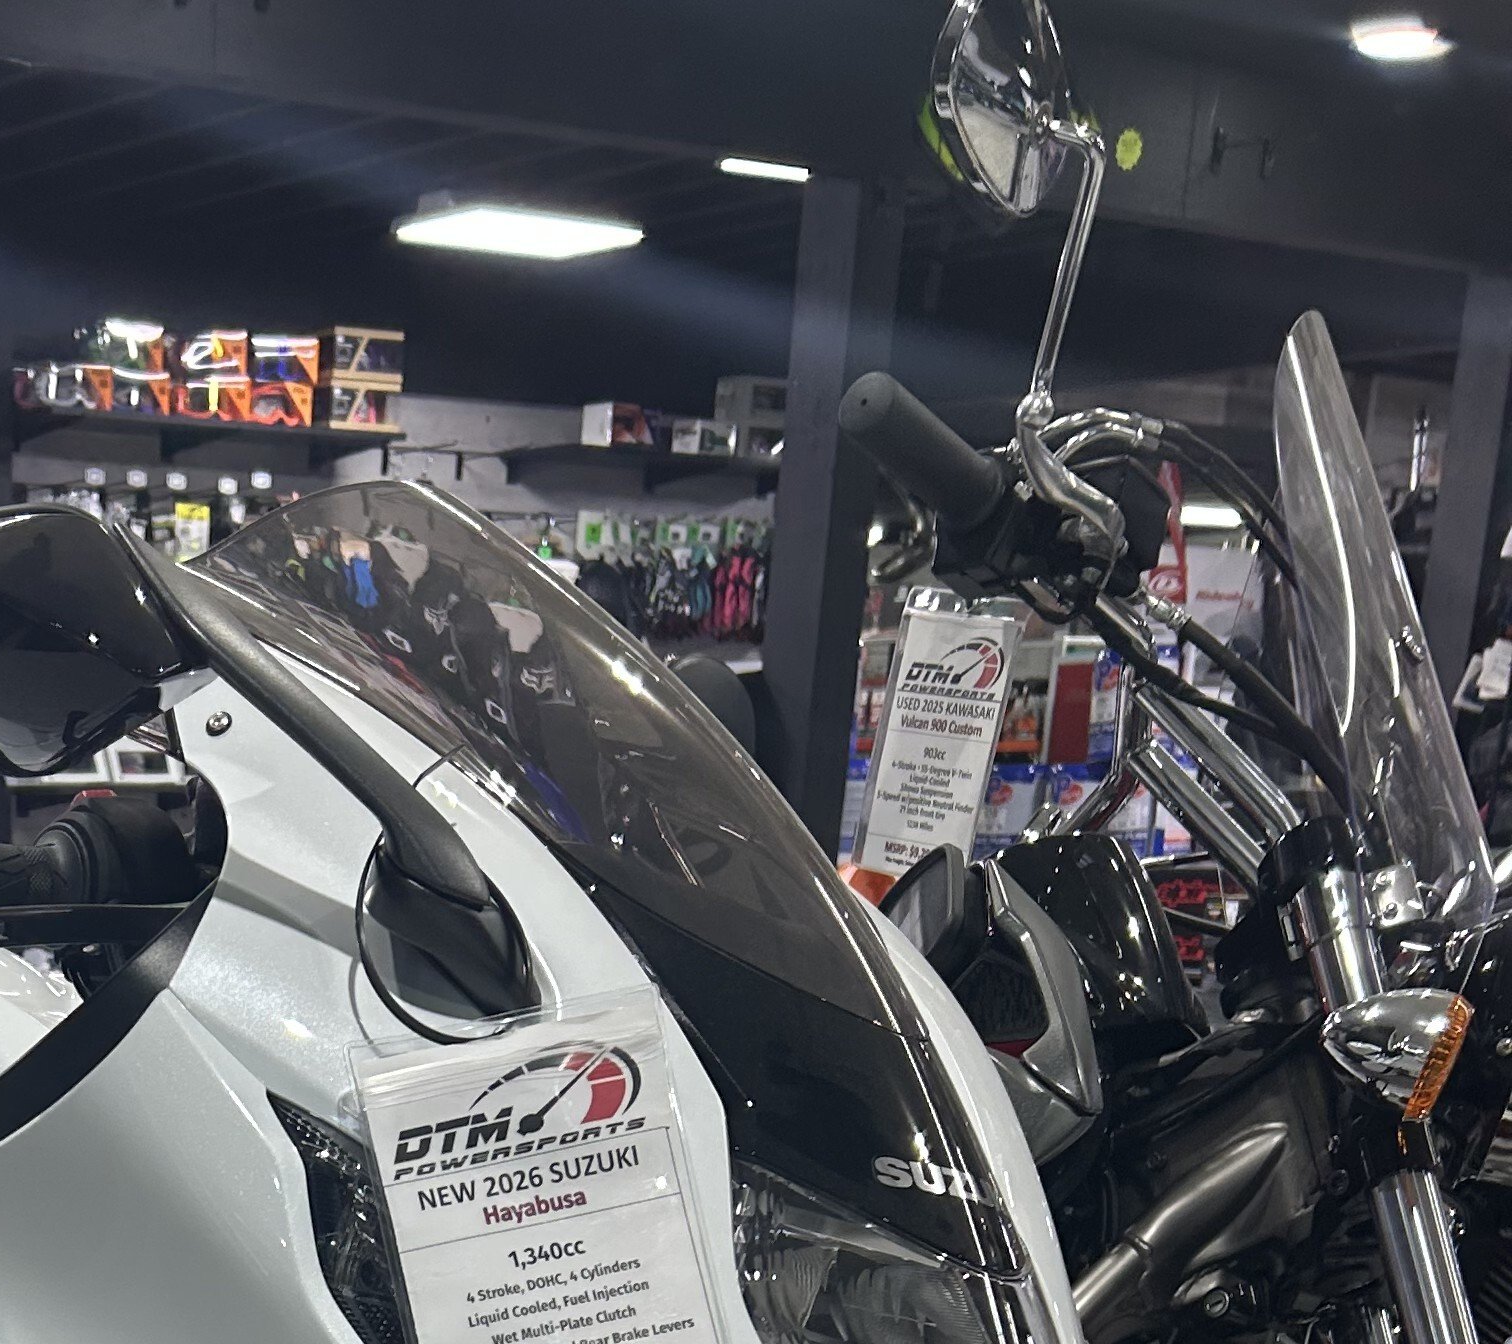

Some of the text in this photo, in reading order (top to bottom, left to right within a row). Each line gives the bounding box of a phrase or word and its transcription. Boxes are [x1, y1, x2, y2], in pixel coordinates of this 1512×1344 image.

[905, 662, 955, 684] DTM
[901, 683, 996, 700] POWERSPORTS
[896, 696, 996, 720] USED 2025 KAWASAKI
[901, 714, 983, 737] Vulcan 900 Custom
[923, 747, 946, 760] 903cc
[393, 1106, 514, 1164] DTM
[393, 1117, 647, 1181] POWERSPORTS
[417, 1145, 640, 1211] NEW 2026 SUZUKI
[483, 1190, 588, 1225] Hayabusa
[508, 1240, 586, 1270] 1,340cc
[466, 1258, 641, 1304] 4 Stroke, DOHC, 4 Cylinders
[468, 1279, 650, 1329] Liquid Cooled, Fuel Injection
[521, 1316, 593, 1340] Multi-Plate
[595, 1305, 637, 1324] Clutch
[612, 1326, 650, 1344] Brake
[652, 1316, 695, 1336] Levers
